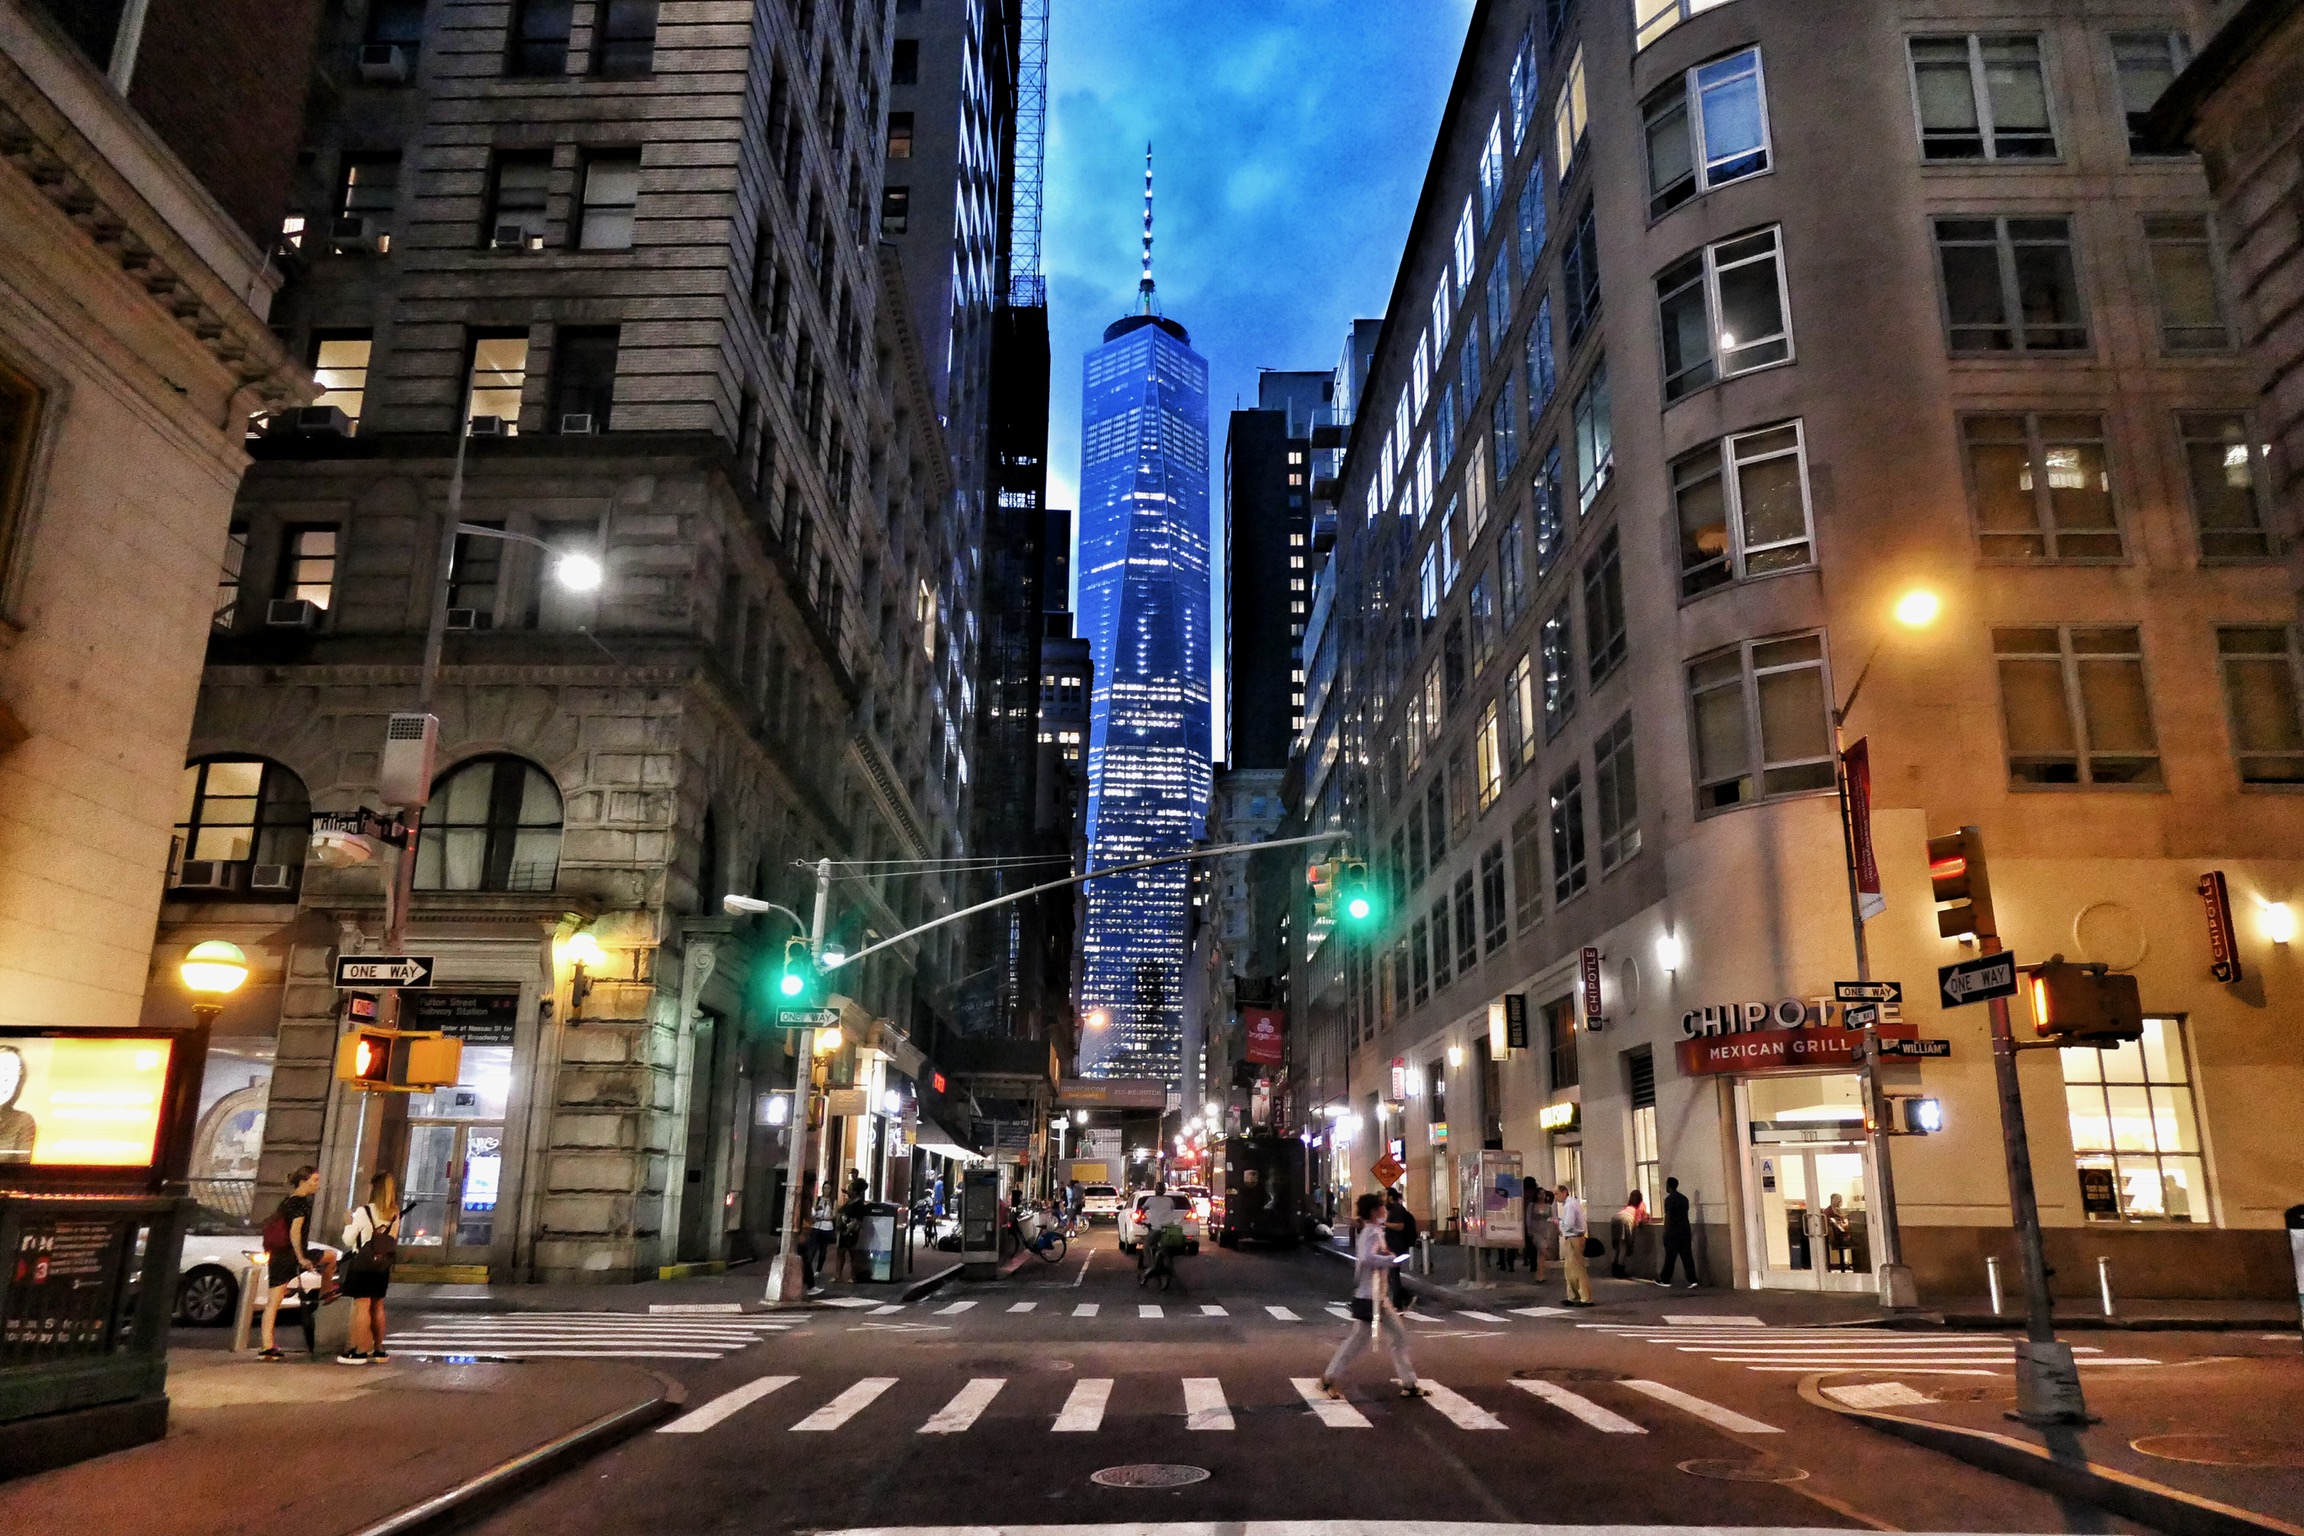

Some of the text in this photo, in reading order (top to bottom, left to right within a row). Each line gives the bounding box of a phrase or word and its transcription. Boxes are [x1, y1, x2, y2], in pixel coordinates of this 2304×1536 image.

[312, 818, 358, 834] William
[2202, 877, 2222, 958] CHIPOTLE
[350, 965, 419, 977] ONE WAY
[1586, 950, 1599, 1013] CHIPOTLE
[1951, 966, 2005, 993] ONE WAY
[1844, 987, 1892, 997] ONE WAY
[450, 998, 477, 1007] Street
[419, 1008, 489, 1017] Subway Station
[811, 1013, 832, 1021] WAY
[1681, 995, 1904, 1039] CHIPOTE
[1710, 1042, 1784, 1060] MEXICAN
[1793, 1038, 1852, 1054] GRILL
[1902, 1043, 1942, 1054] WILLIAM
[1763, 1161, 1771, 1171] A
